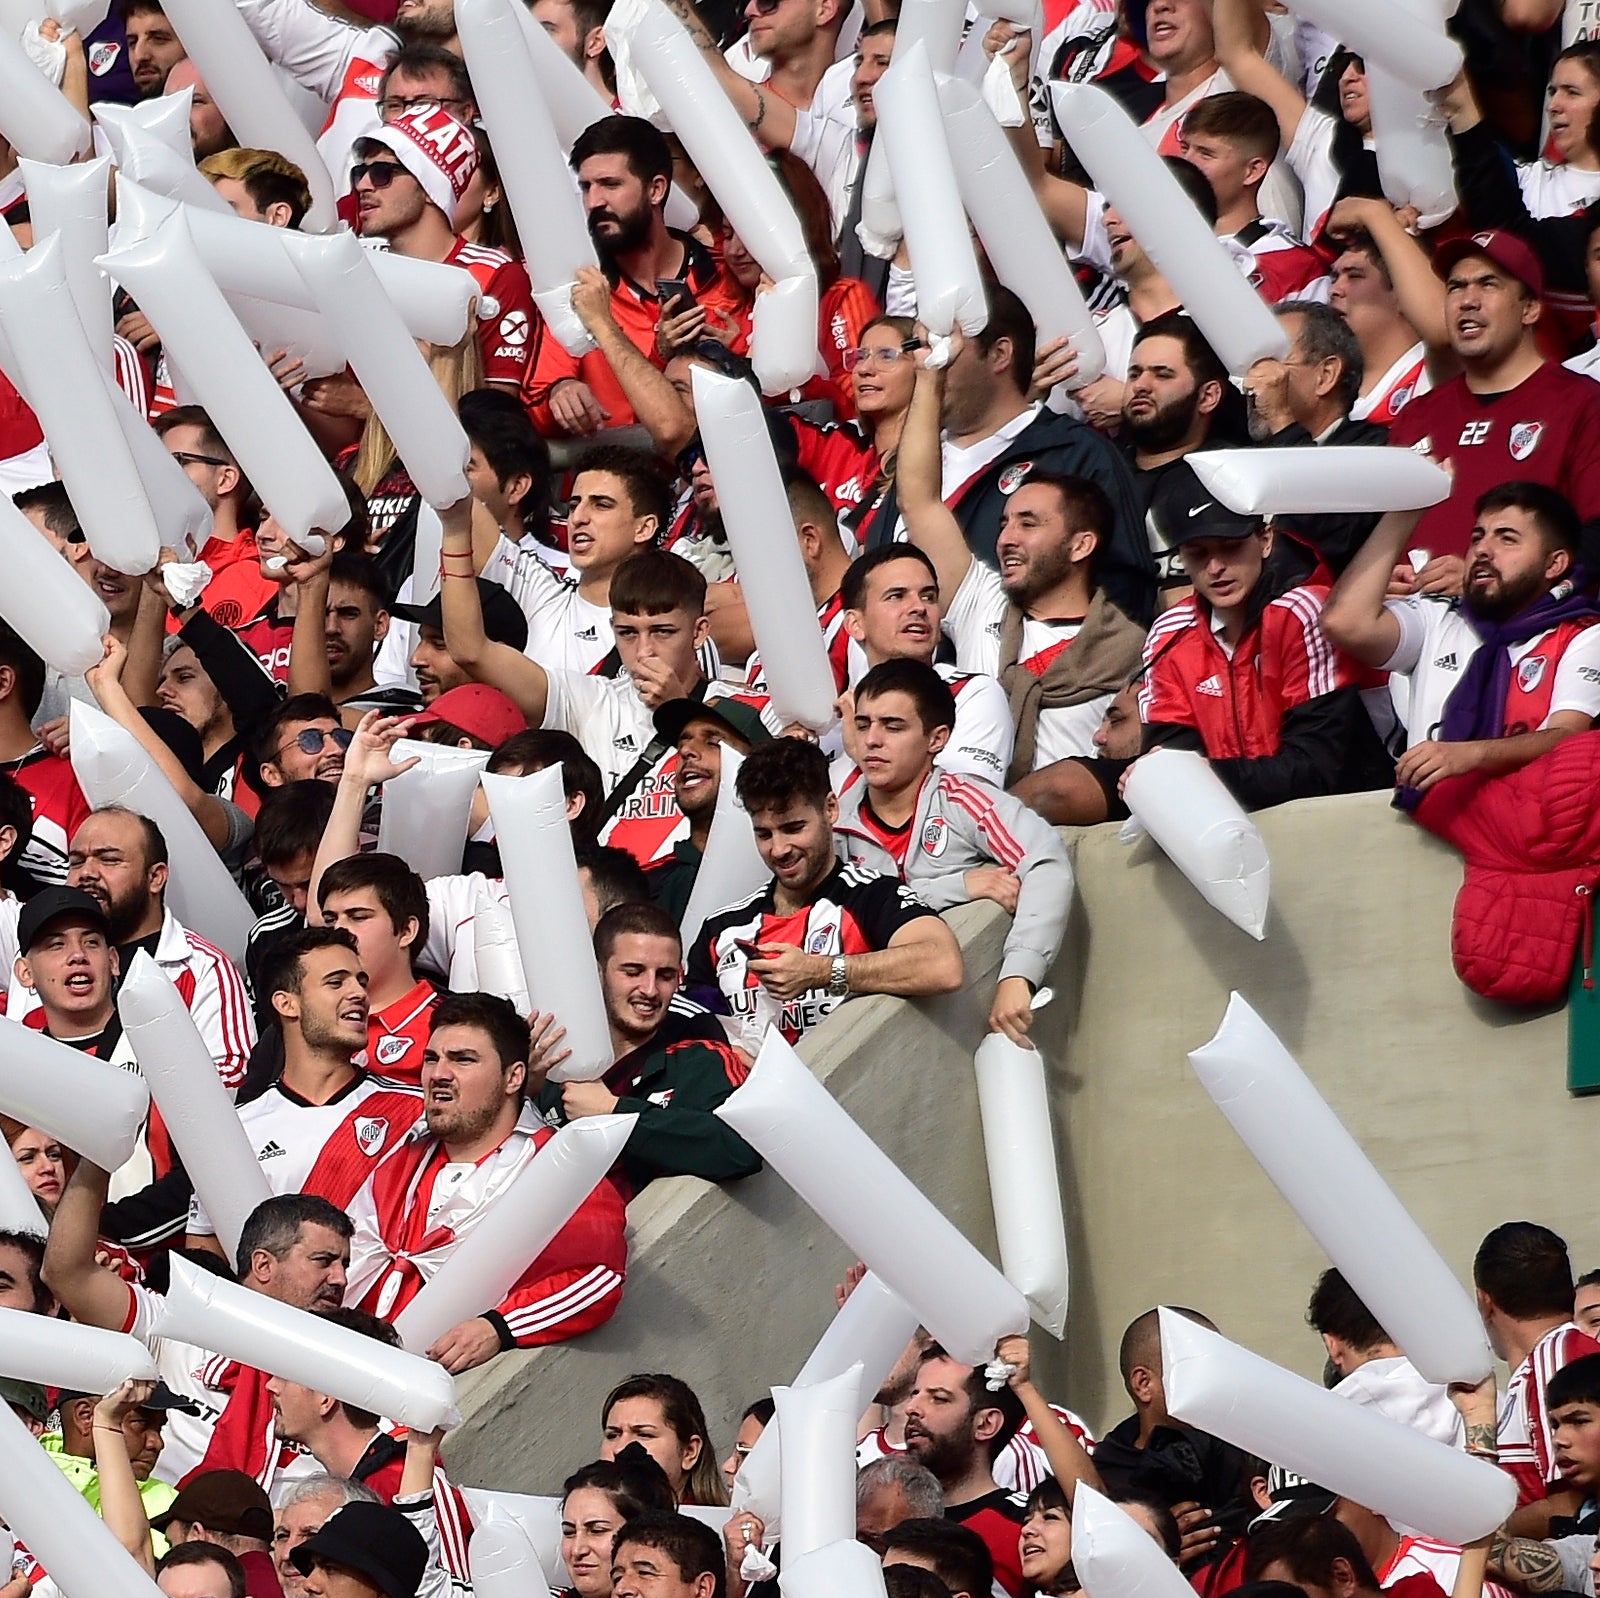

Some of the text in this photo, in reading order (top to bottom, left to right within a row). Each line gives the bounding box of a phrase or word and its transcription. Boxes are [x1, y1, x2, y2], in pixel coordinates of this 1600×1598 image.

[403, 102, 481, 184] PLATE
[1457, 420, 1491, 446] 22
[608, 768, 676, 799] TRK
[257, 1148, 287, 1163] adidas
